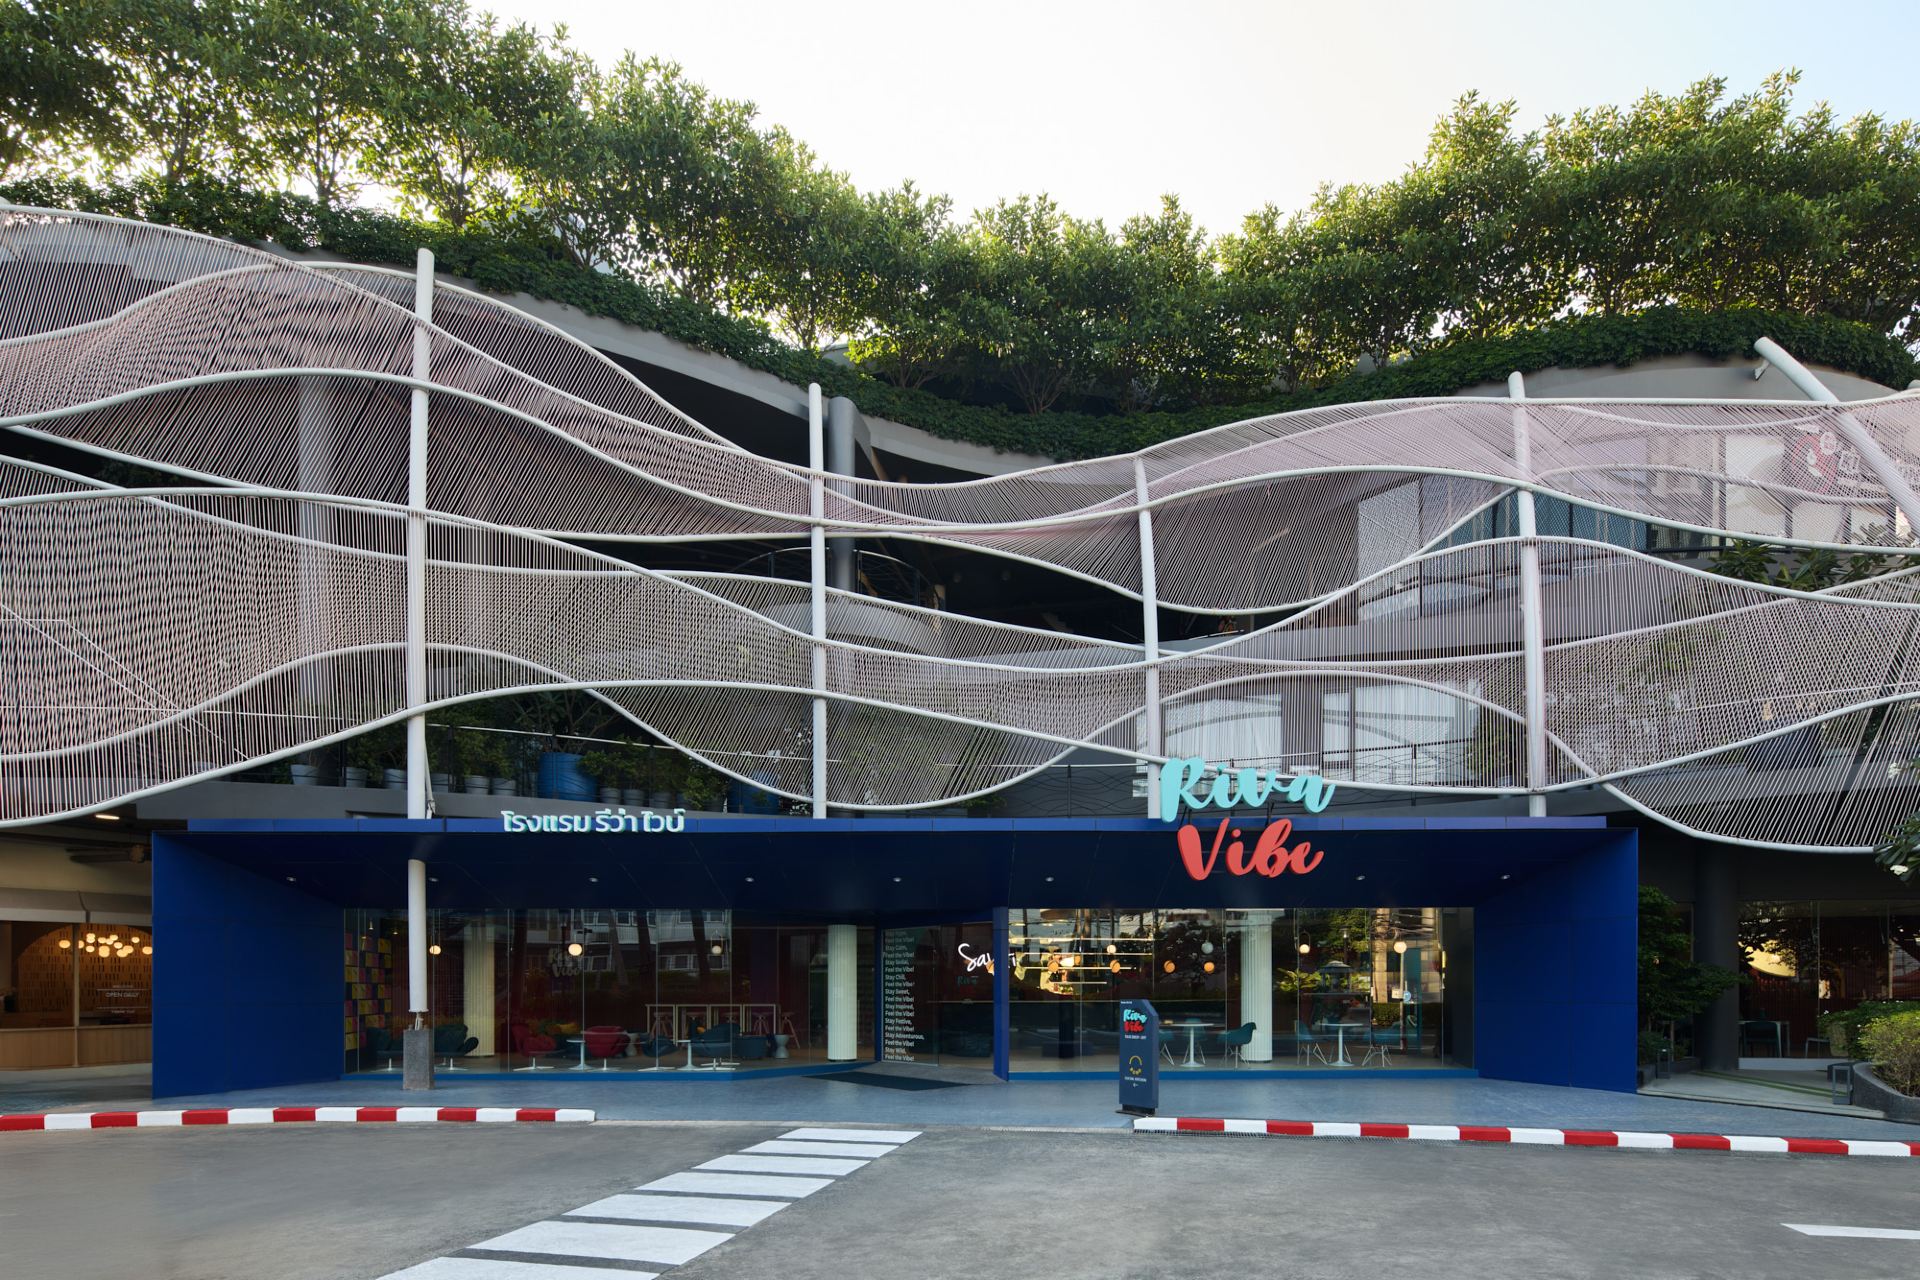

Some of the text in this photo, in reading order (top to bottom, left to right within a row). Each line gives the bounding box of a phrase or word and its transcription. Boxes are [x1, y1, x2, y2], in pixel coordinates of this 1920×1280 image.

[1160, 756, 1336, 823] Riva
[501, 808, 686, 833] โรงแรม รีว่า ไวบ์
[1177, 817, 1325, 881] Vibe
[1123, 1009, 1148, 1024] Riva
